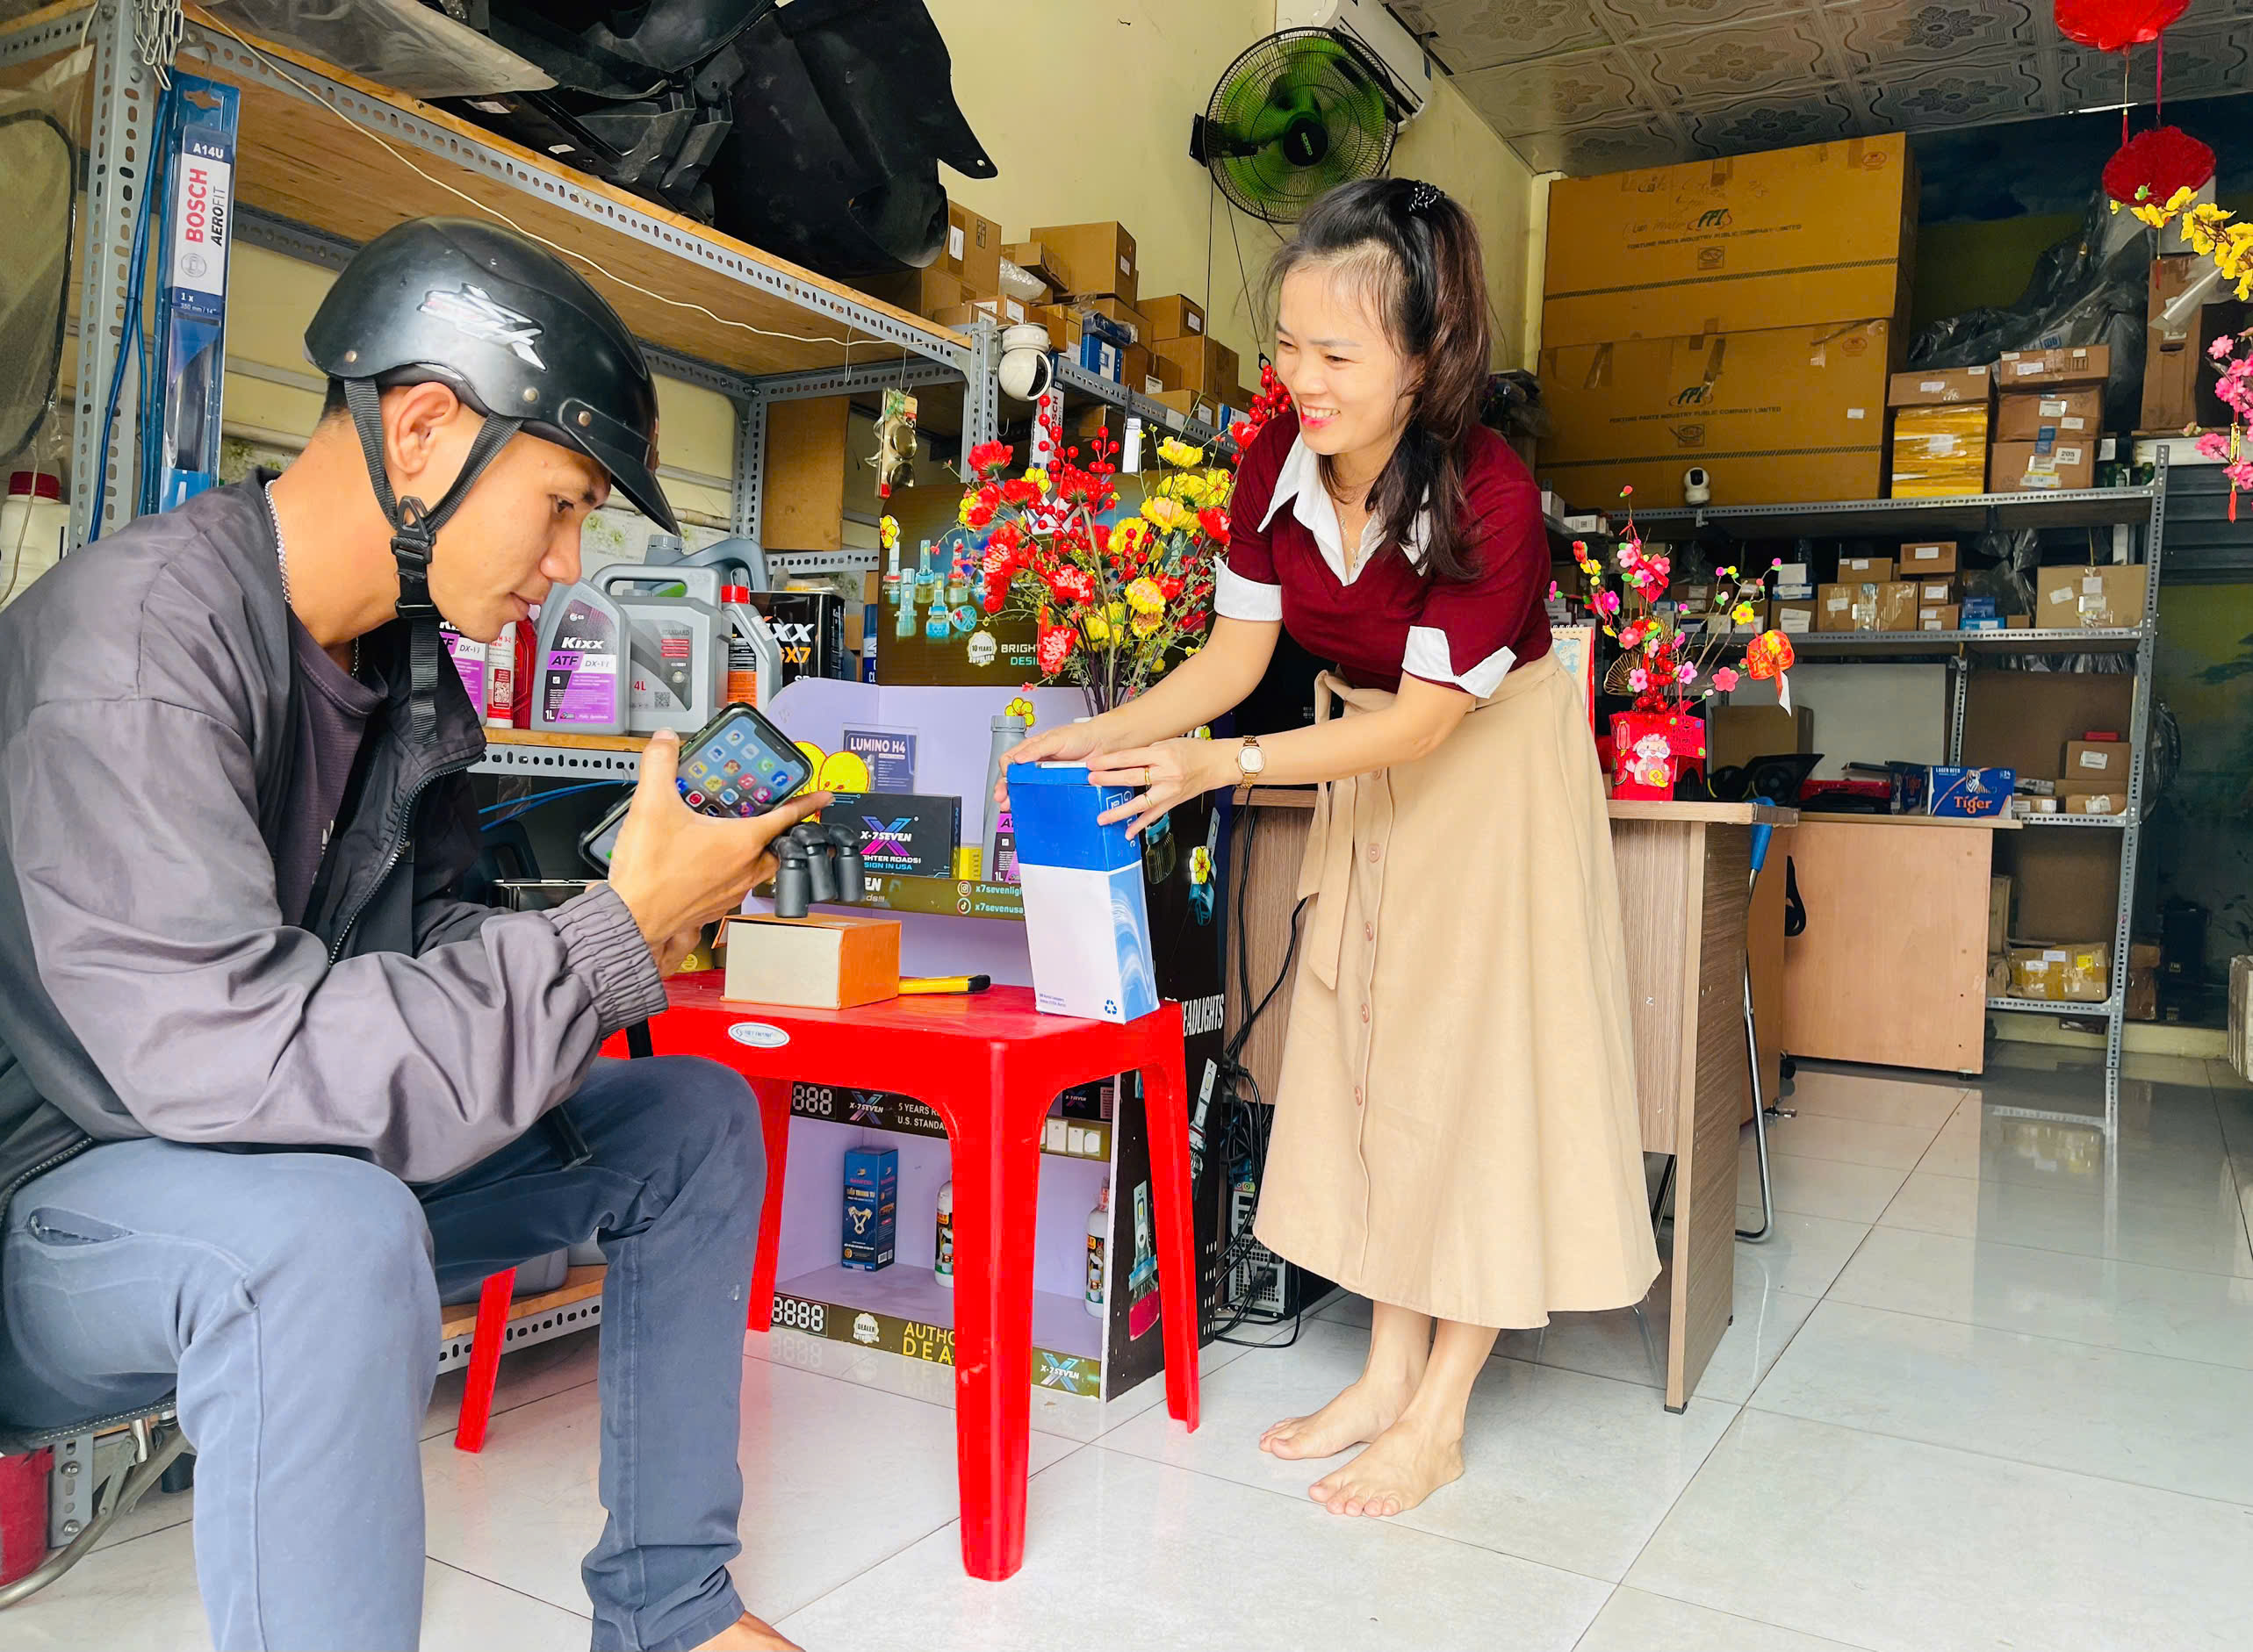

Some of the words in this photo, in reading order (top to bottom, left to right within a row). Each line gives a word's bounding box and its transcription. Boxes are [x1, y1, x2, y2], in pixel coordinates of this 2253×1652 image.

[193, 143, 224, 158] A14U
[185, 168, 208, 243] BOSCH
[211, 185, 226, 247] AEROFIT
[561, 636, 604, 649] Kixx
[1001, 643, 1037, 654] BRIGH
[551, 656, 579, 666] ATF
[1011, 657, 1040, 665] DESI
[634, 680, 646, 691] 4L
[544, 710, 555, 720] 1L
[850, 737, 890, 752] LUMINO
[892, 740, 906, 753] H4
[1954, 795, 1992, 815] Tiger
[995, 872, 1004, 881] 1L
[1182, 993, 1225, 1037] EADLIGHTS
[898, 1103, 903, 1111] 5
[904, 1103, 930, 1115] YEARS
[897, 1116, 912, 1126] U.S.
[913, 1117, 947, 1131] STANDA
